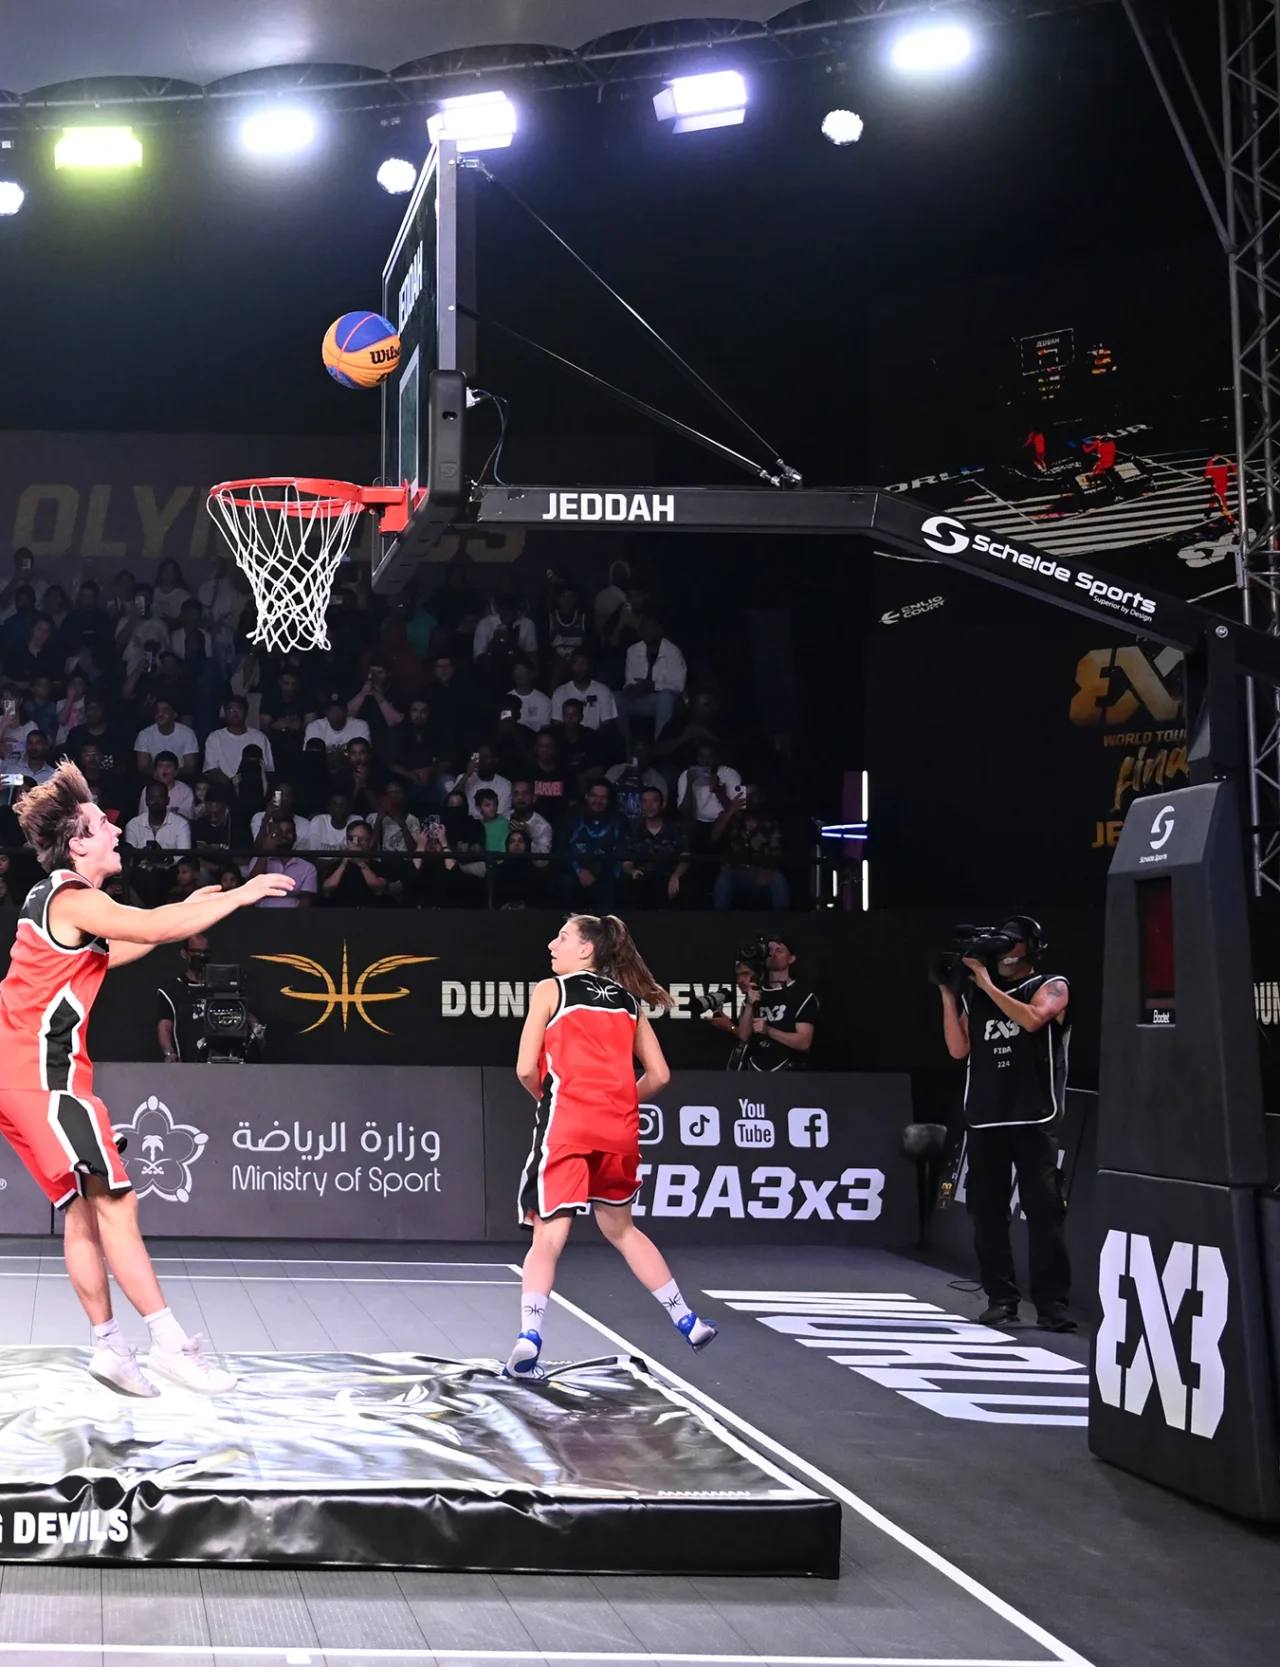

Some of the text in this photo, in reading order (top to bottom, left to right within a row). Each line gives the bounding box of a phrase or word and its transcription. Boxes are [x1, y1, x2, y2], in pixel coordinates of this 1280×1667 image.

[542, 493, 675, 522] JEDDAH
[972, 534, 1156, 613] Schelde Sports
[1104, 728, 1186, 747] WORLD TOU
[738, 1098, 765, 1119] You
[232, 1120, 441, 1161] وزارة الرياضة
[737, 1124, 772, 1144] Tube
[232, 1164, 442, 1198] Ministry of Sport
[631, 1164, 886, 1222] IBA3x3
[13, 1509, 129, 1544] DEVILS
